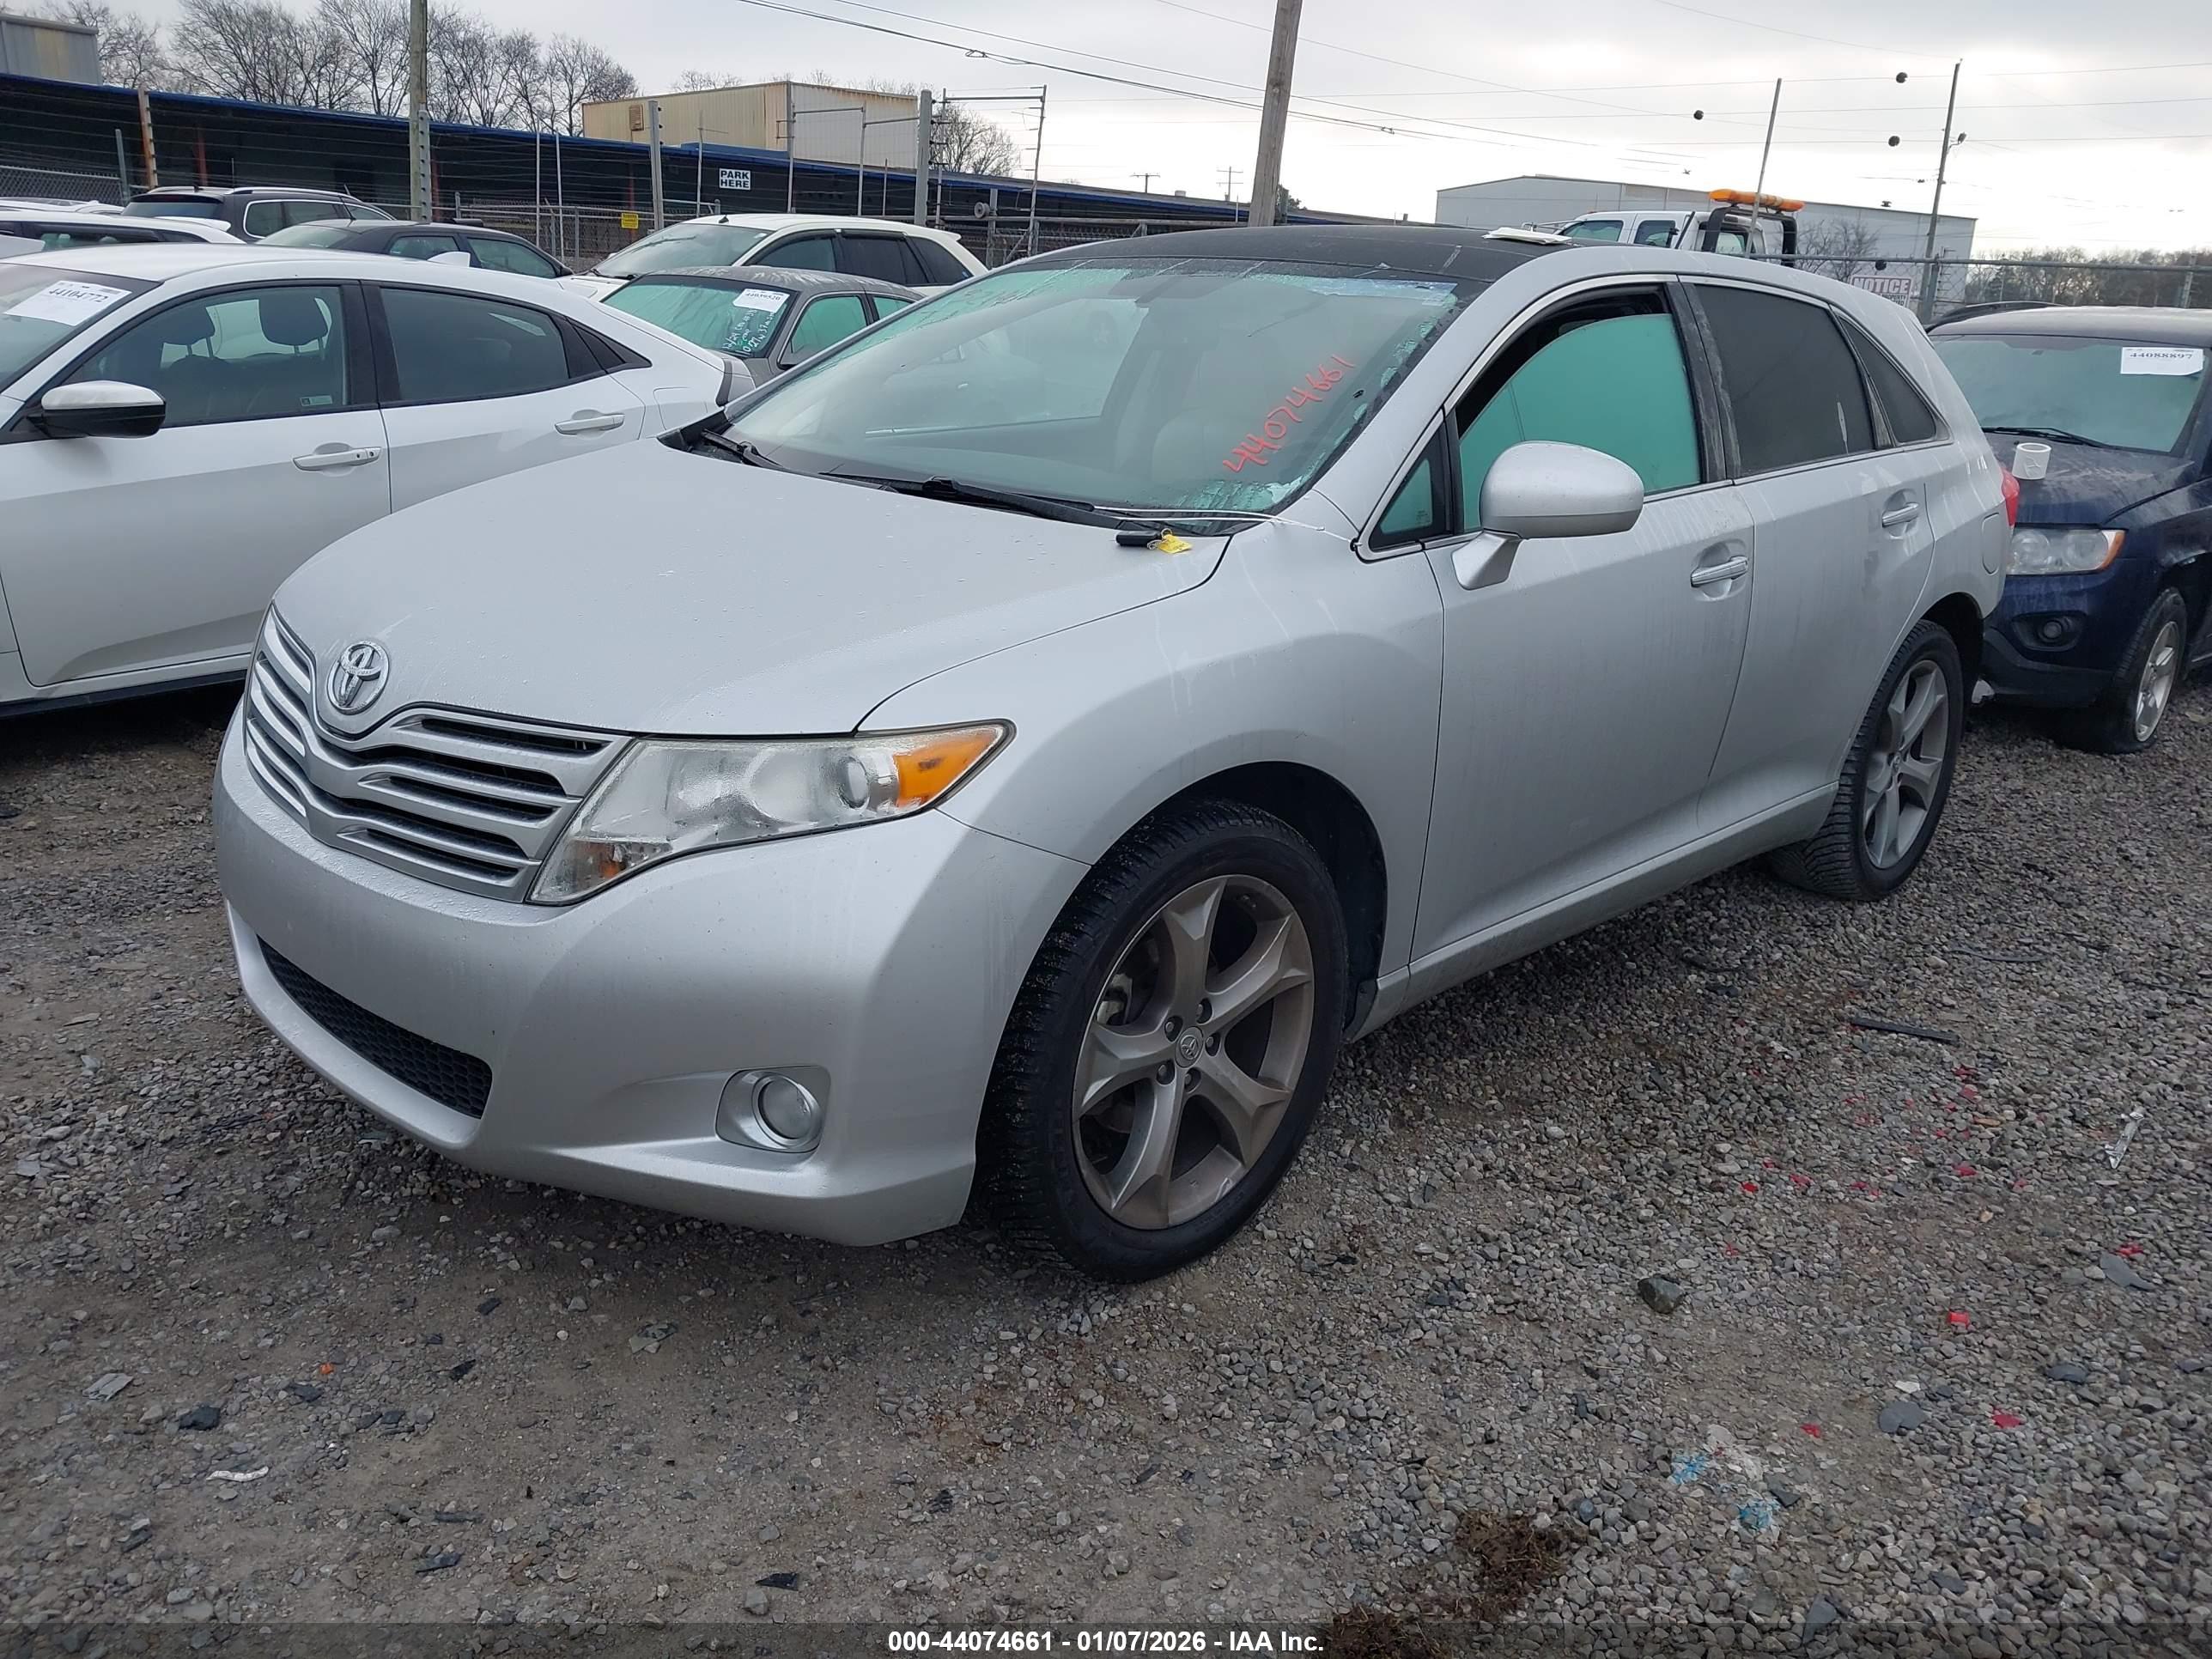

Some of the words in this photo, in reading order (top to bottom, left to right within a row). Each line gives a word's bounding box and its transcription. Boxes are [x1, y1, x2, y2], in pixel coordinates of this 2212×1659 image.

[720, 170, 750, 179] PARK
[720, 179, 750, 188] HERE
[1854, 277, 1910, 293] NOTICE
[1222, 354, 1356, 472] 44074661
